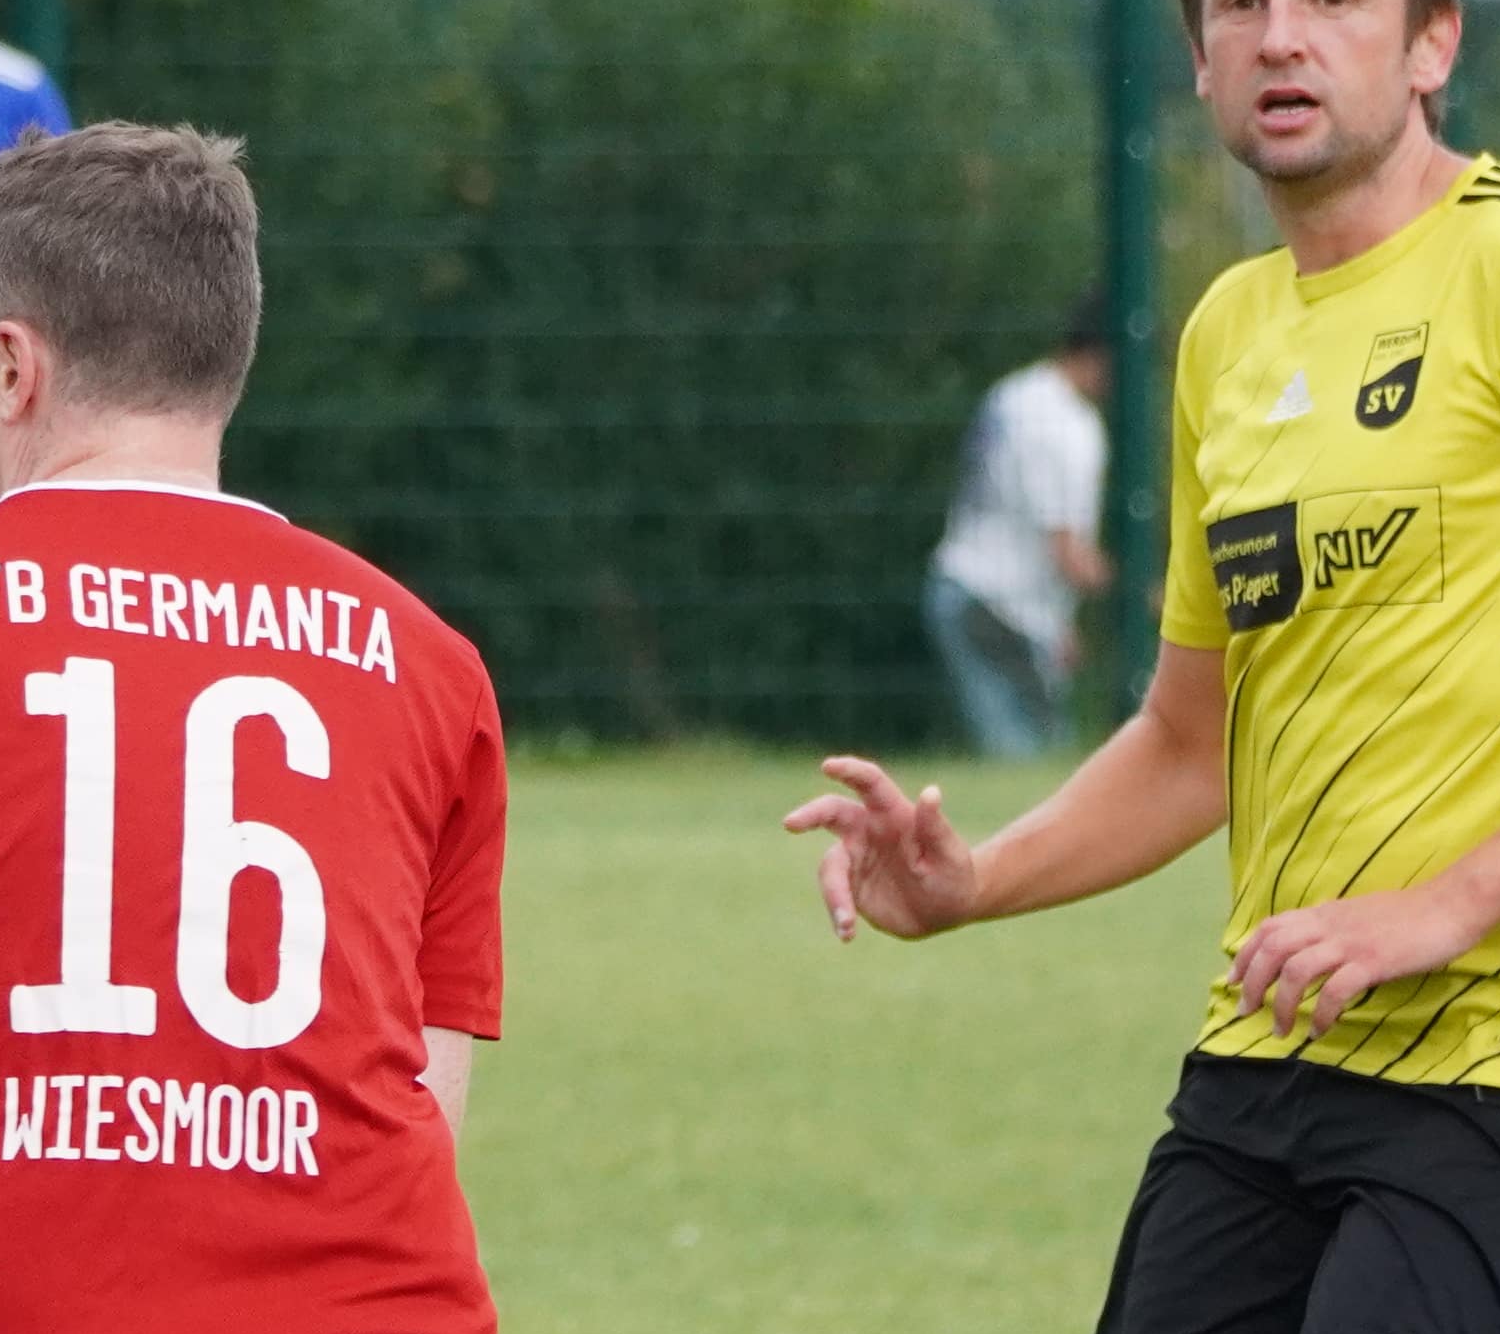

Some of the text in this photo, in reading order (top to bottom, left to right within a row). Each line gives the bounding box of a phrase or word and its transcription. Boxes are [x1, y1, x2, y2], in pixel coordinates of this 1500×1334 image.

[1364, 383, 1406, 414] SV
[1314, 507, 1419, 588] NV
[68, 563, 397, 684] GERMANIA
[9, 655, 331, 1050] 16
[1, 1074, 319, 1176] WIESMOOR
